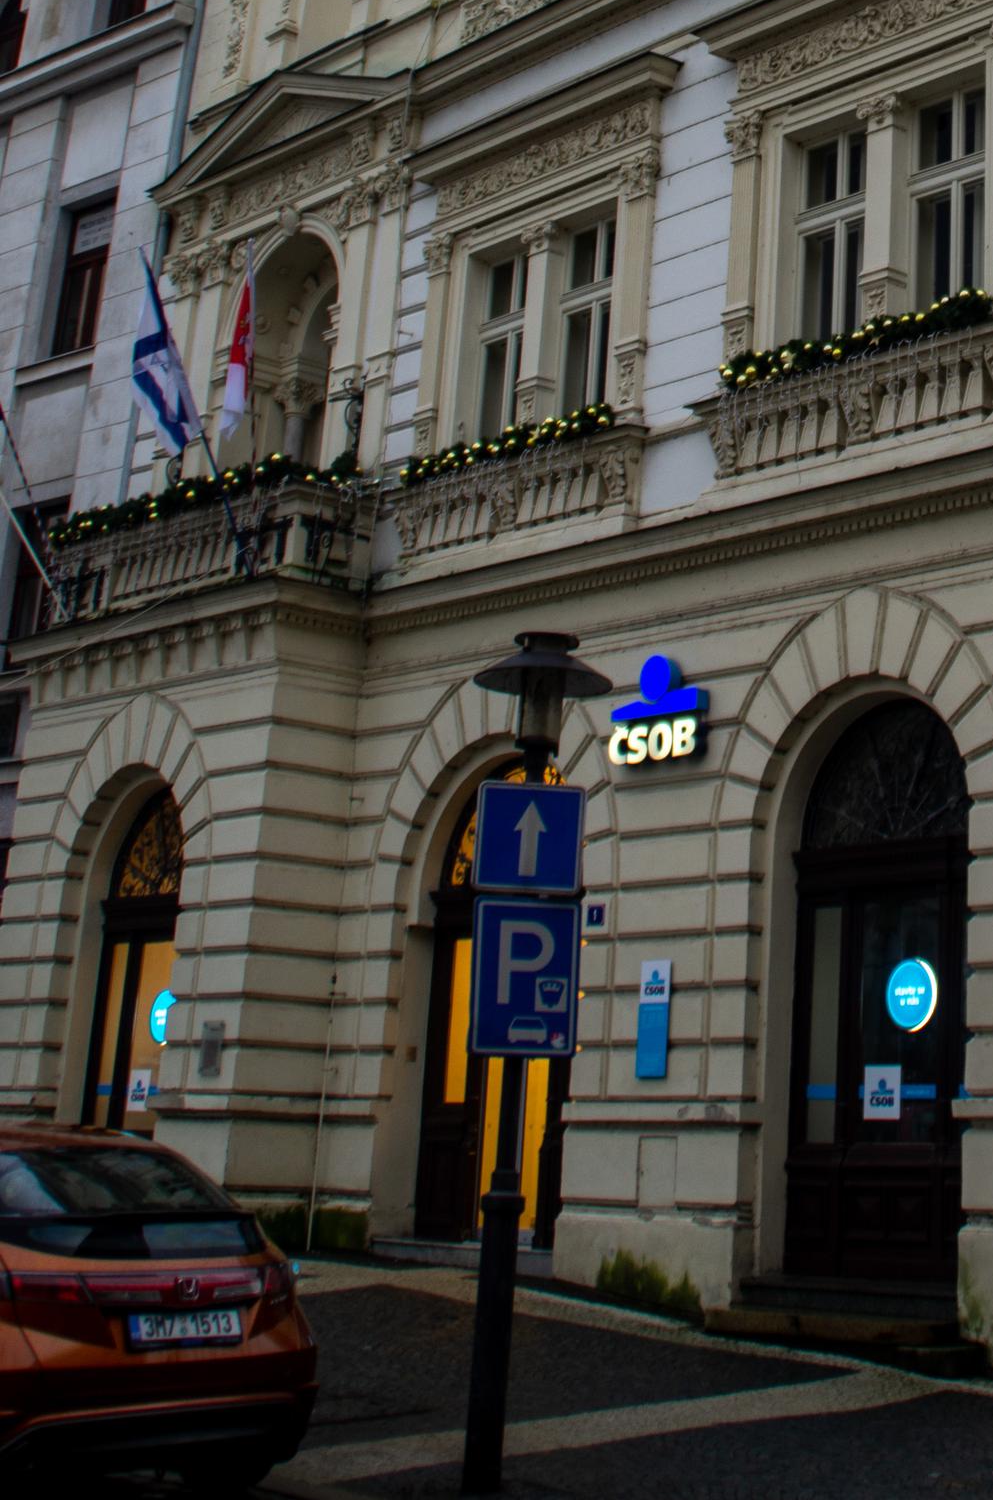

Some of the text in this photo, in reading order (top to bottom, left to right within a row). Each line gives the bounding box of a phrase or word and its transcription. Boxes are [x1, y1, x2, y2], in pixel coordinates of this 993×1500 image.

[609, 718, 696, 765] ČSOB
[497, 919, 556, 1006] P
[869, 1095, 895, 1108] ČSOB
[144, 1312, 233, 1338] 3M7 1513
